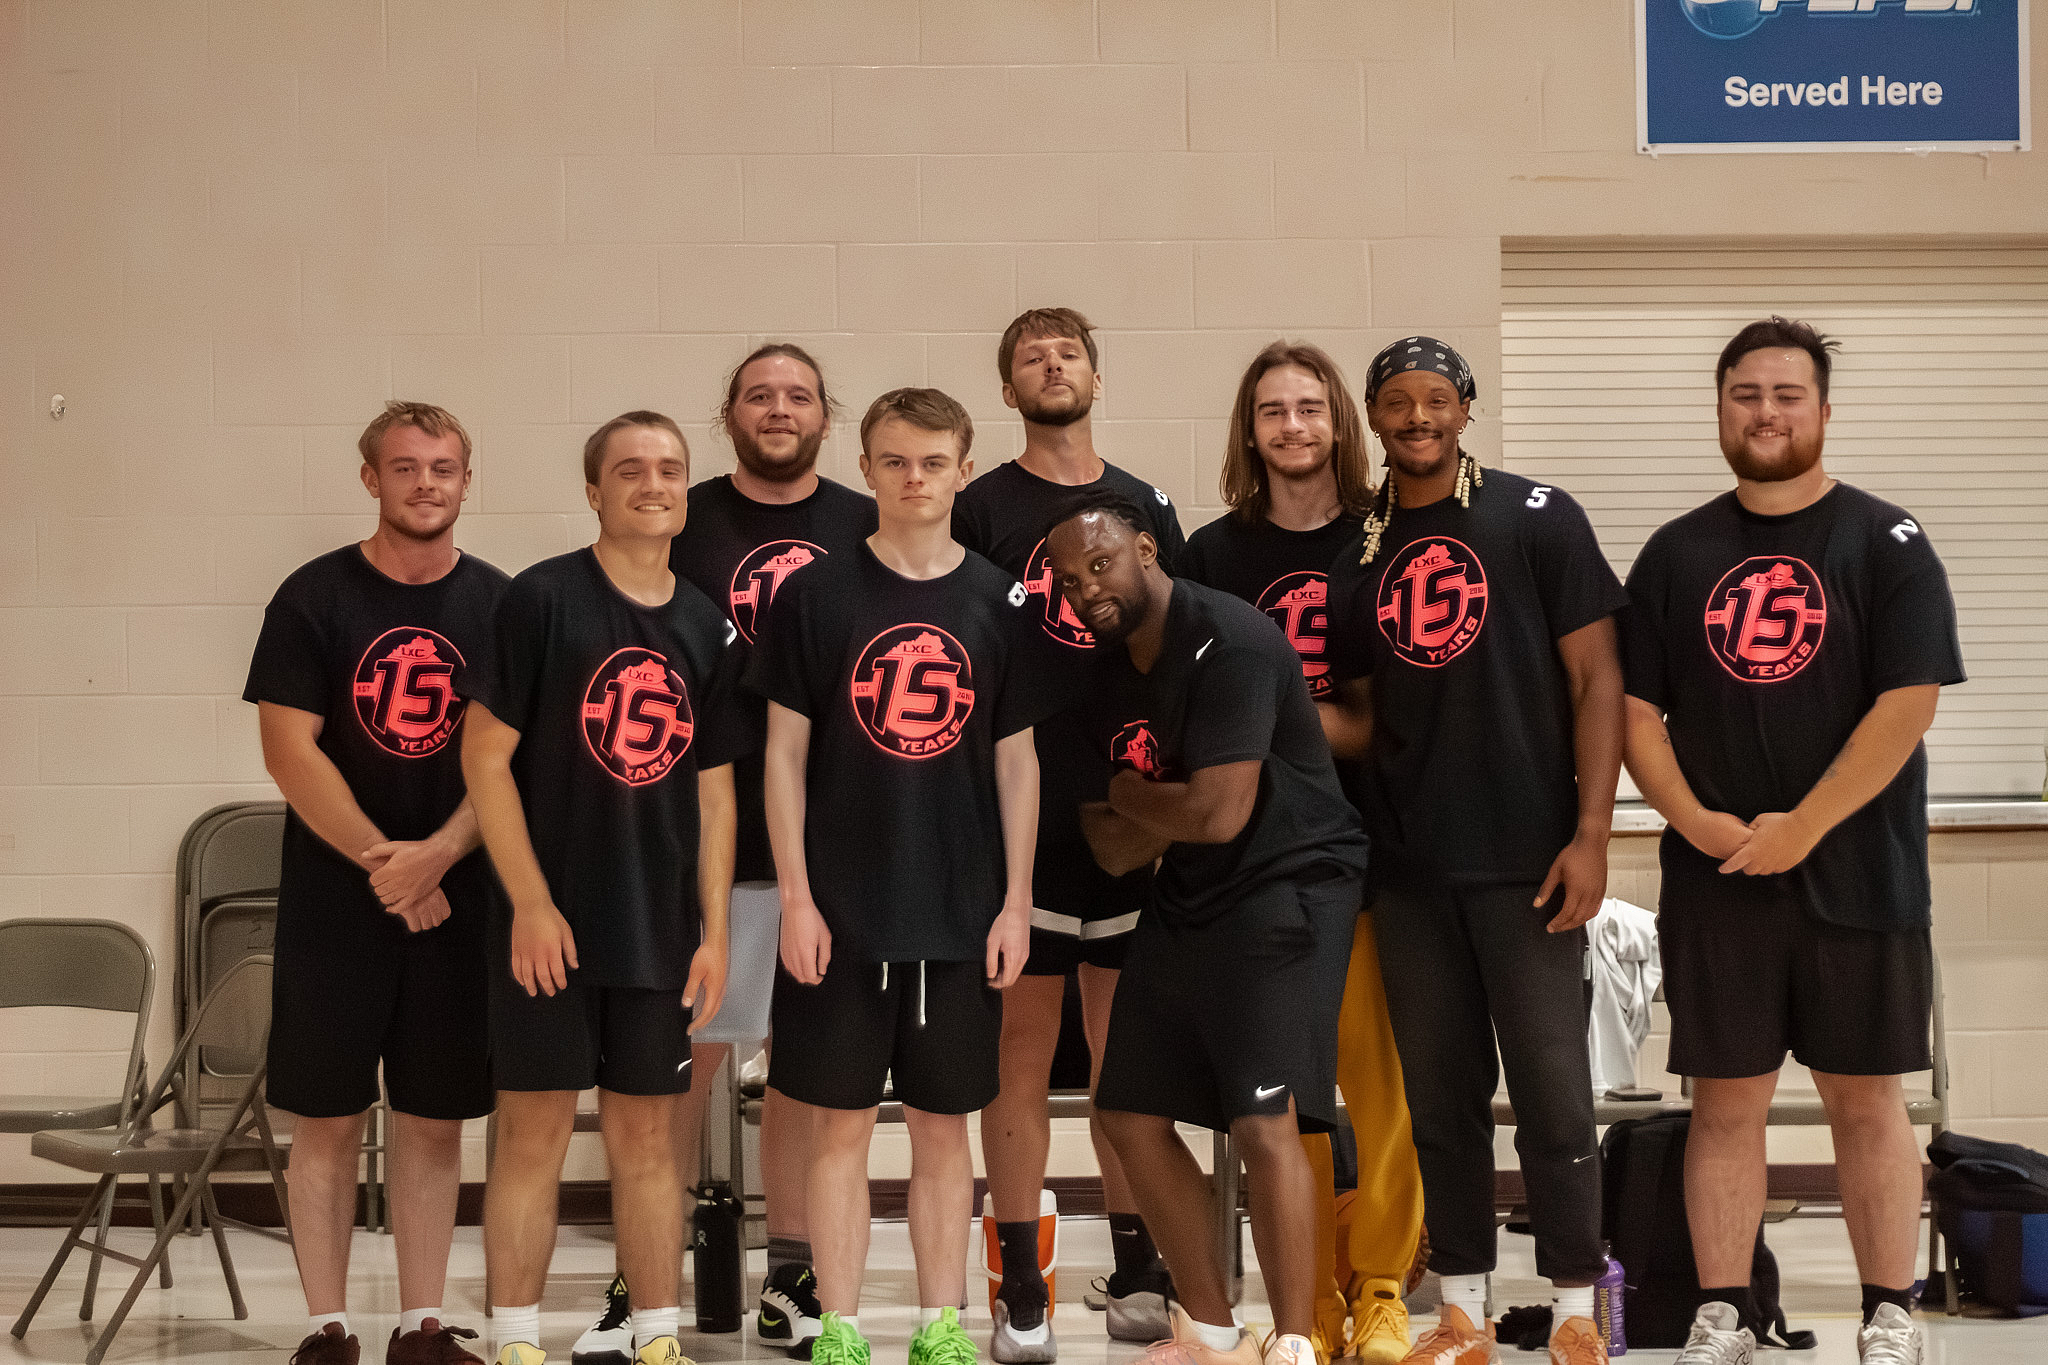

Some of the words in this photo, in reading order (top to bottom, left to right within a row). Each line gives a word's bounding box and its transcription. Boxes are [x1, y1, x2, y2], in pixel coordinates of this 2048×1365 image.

[1724, 75, 1849, 107] Served
[1861, 75, 1943, 106] Here
[1524, 486, 1552, 509] 5
[1890, 518, 1919, 543] 2
[776, 556, 804, 565] LXC
[1414, 555, 1440, 569] LXC
[1007, 581, 1029, 607] 6
[1291, 591, 1320, 600] LXC
[1391, 563, 1467, 651] 15
[1427, 615, 1478, 662] YEARS
[1723, 585, 1810, 663] 15
[902, 643, 932, 654] LXC
[1748, 641, 1812, 677] YEARS
[628, 668, 654, 682] LXC
[856, 685, 870, 693] EST
[372, 658, 455, 735] 15
[872, 657, 962, 736] 15
[600, 679, 682, 760] 15
[898, 718, 961, 753] YEARS
